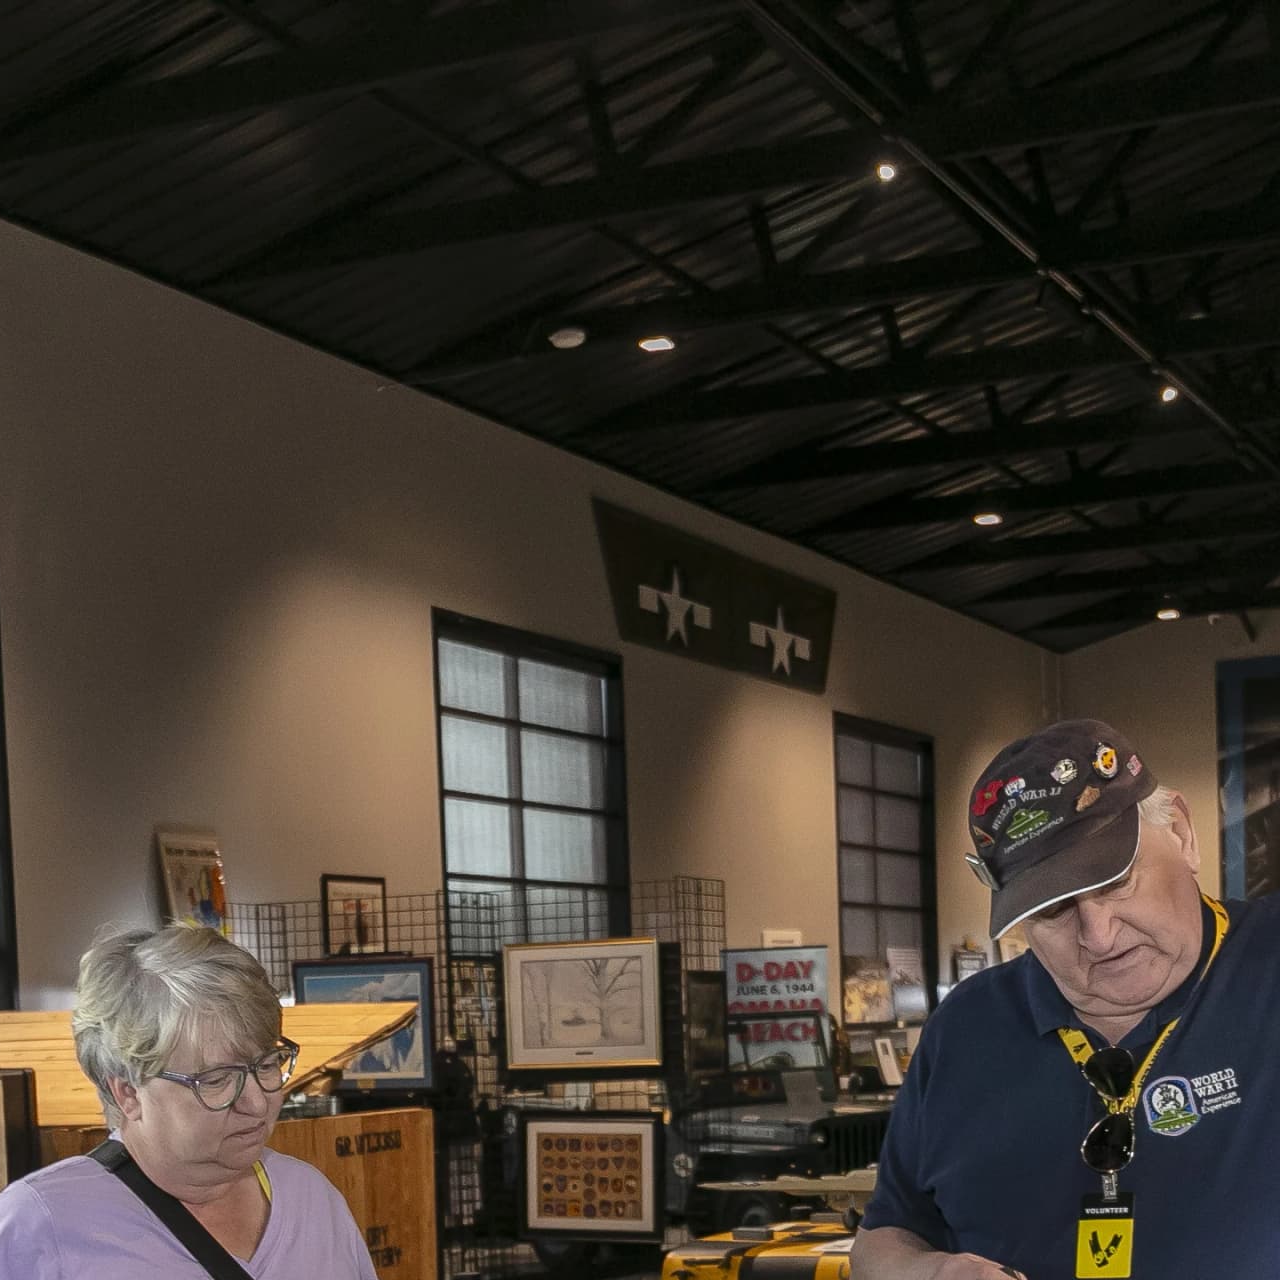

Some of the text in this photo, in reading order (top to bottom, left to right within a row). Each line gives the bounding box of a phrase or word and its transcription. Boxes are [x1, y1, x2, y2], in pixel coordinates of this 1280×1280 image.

[1019, 789, 1047, 803] WAR
[1049, 786, 1062, 797] II
[735, 960, 814, 983] D-DAY
[736, 985, 768, 996] JUNE
[786, 984, 815, 994] 1944
[1190, 1068, 1235, 1088] WORLD
[1194, 1078, 1239, 1098] WAR II
[1200, 1097, 1242, 1114] Experience
[1202, 1091, 1237, 1105] American
